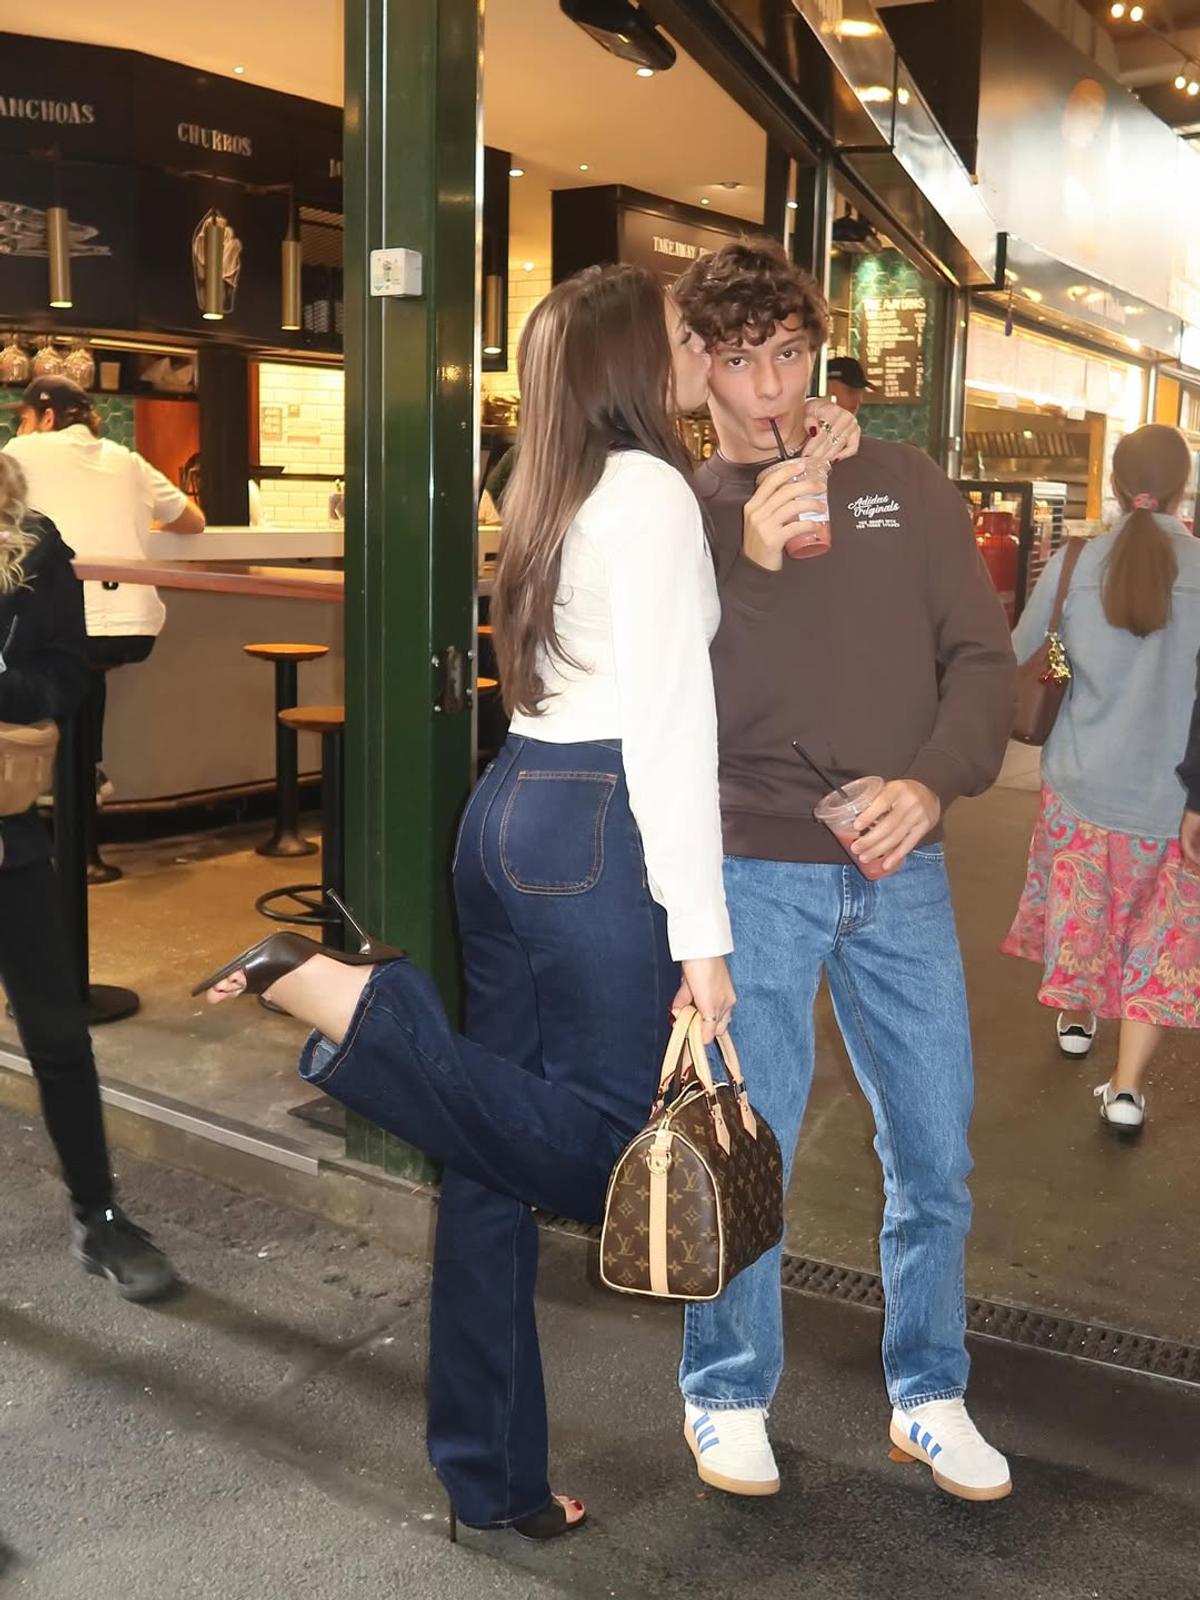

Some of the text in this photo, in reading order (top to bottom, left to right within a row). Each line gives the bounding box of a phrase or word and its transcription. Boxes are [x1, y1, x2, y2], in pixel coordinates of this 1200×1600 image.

[177, 122, 252, 157] CHURROS
[653, 236, 697, 259] TAKEAWAY
[848, 495, 888, 509] Adidas
[854, 501, 900, 517] Originals
